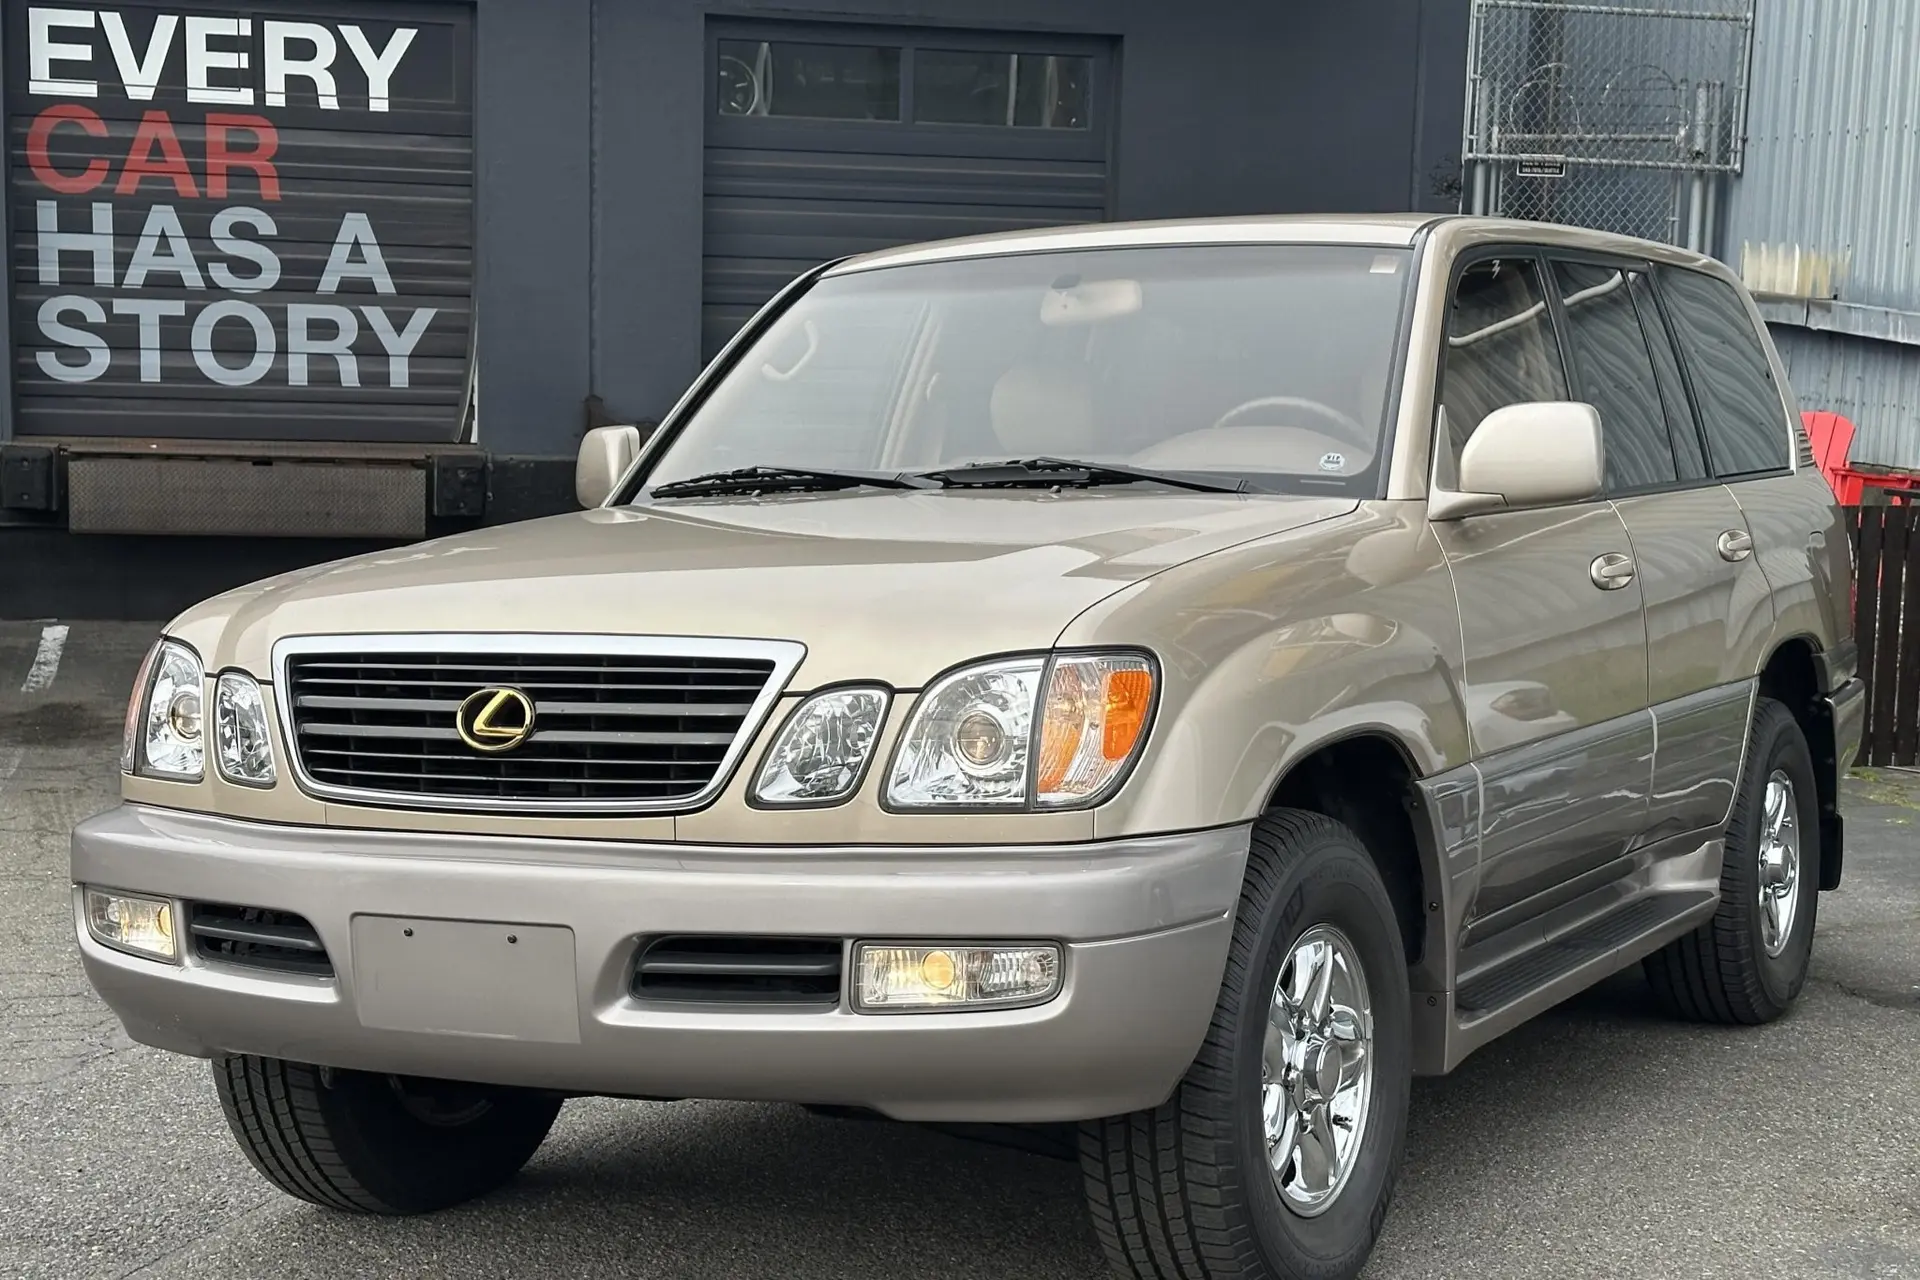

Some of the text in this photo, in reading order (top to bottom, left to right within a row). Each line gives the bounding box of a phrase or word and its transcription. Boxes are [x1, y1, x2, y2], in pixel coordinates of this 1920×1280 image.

[28, 6, 418, 112] EVERY
[26, 104, 282, 201] CAR
[36, 199, 398, 296] HAS A
[35, 295, 438, 388] STORY
